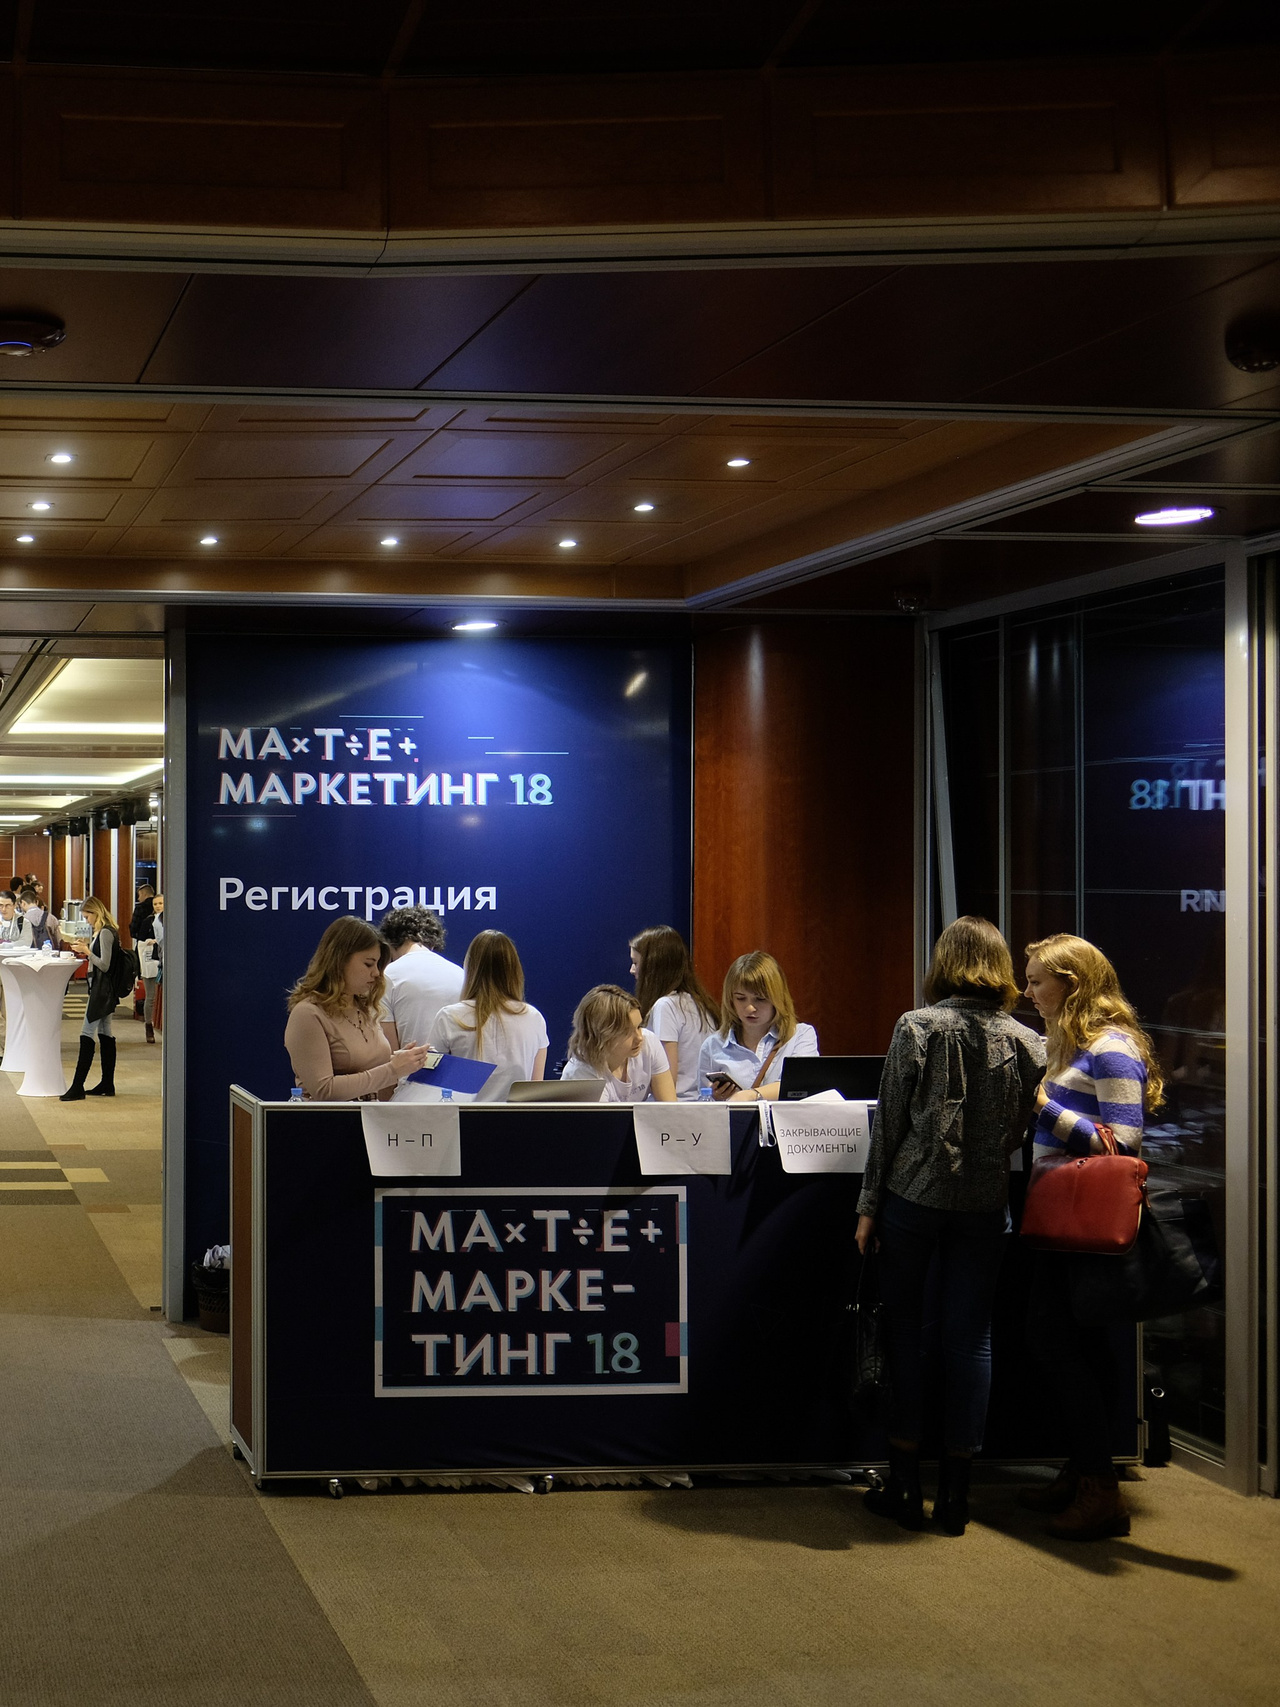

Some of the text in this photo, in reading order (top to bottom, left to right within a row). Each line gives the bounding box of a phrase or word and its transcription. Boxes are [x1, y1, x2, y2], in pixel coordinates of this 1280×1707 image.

[219, 773, 554, 805] МАРКЕТИНГ 18
[219, 877, 497, 921] Регистрация
[387, 1133, 399, 1147] Н
[422, 1133, 433, 1147] П
[661, 1132, 671, 1146] Р
[691, 1132, 702, 1146] У
[780, 1128, 862, 1138] ЗАКРЫВАЮЩИЕ
[786, 1143, 857, 1155] ДОКУМЕНТЫ
[410, 1332, 642, 1376] ТИНГ 18
